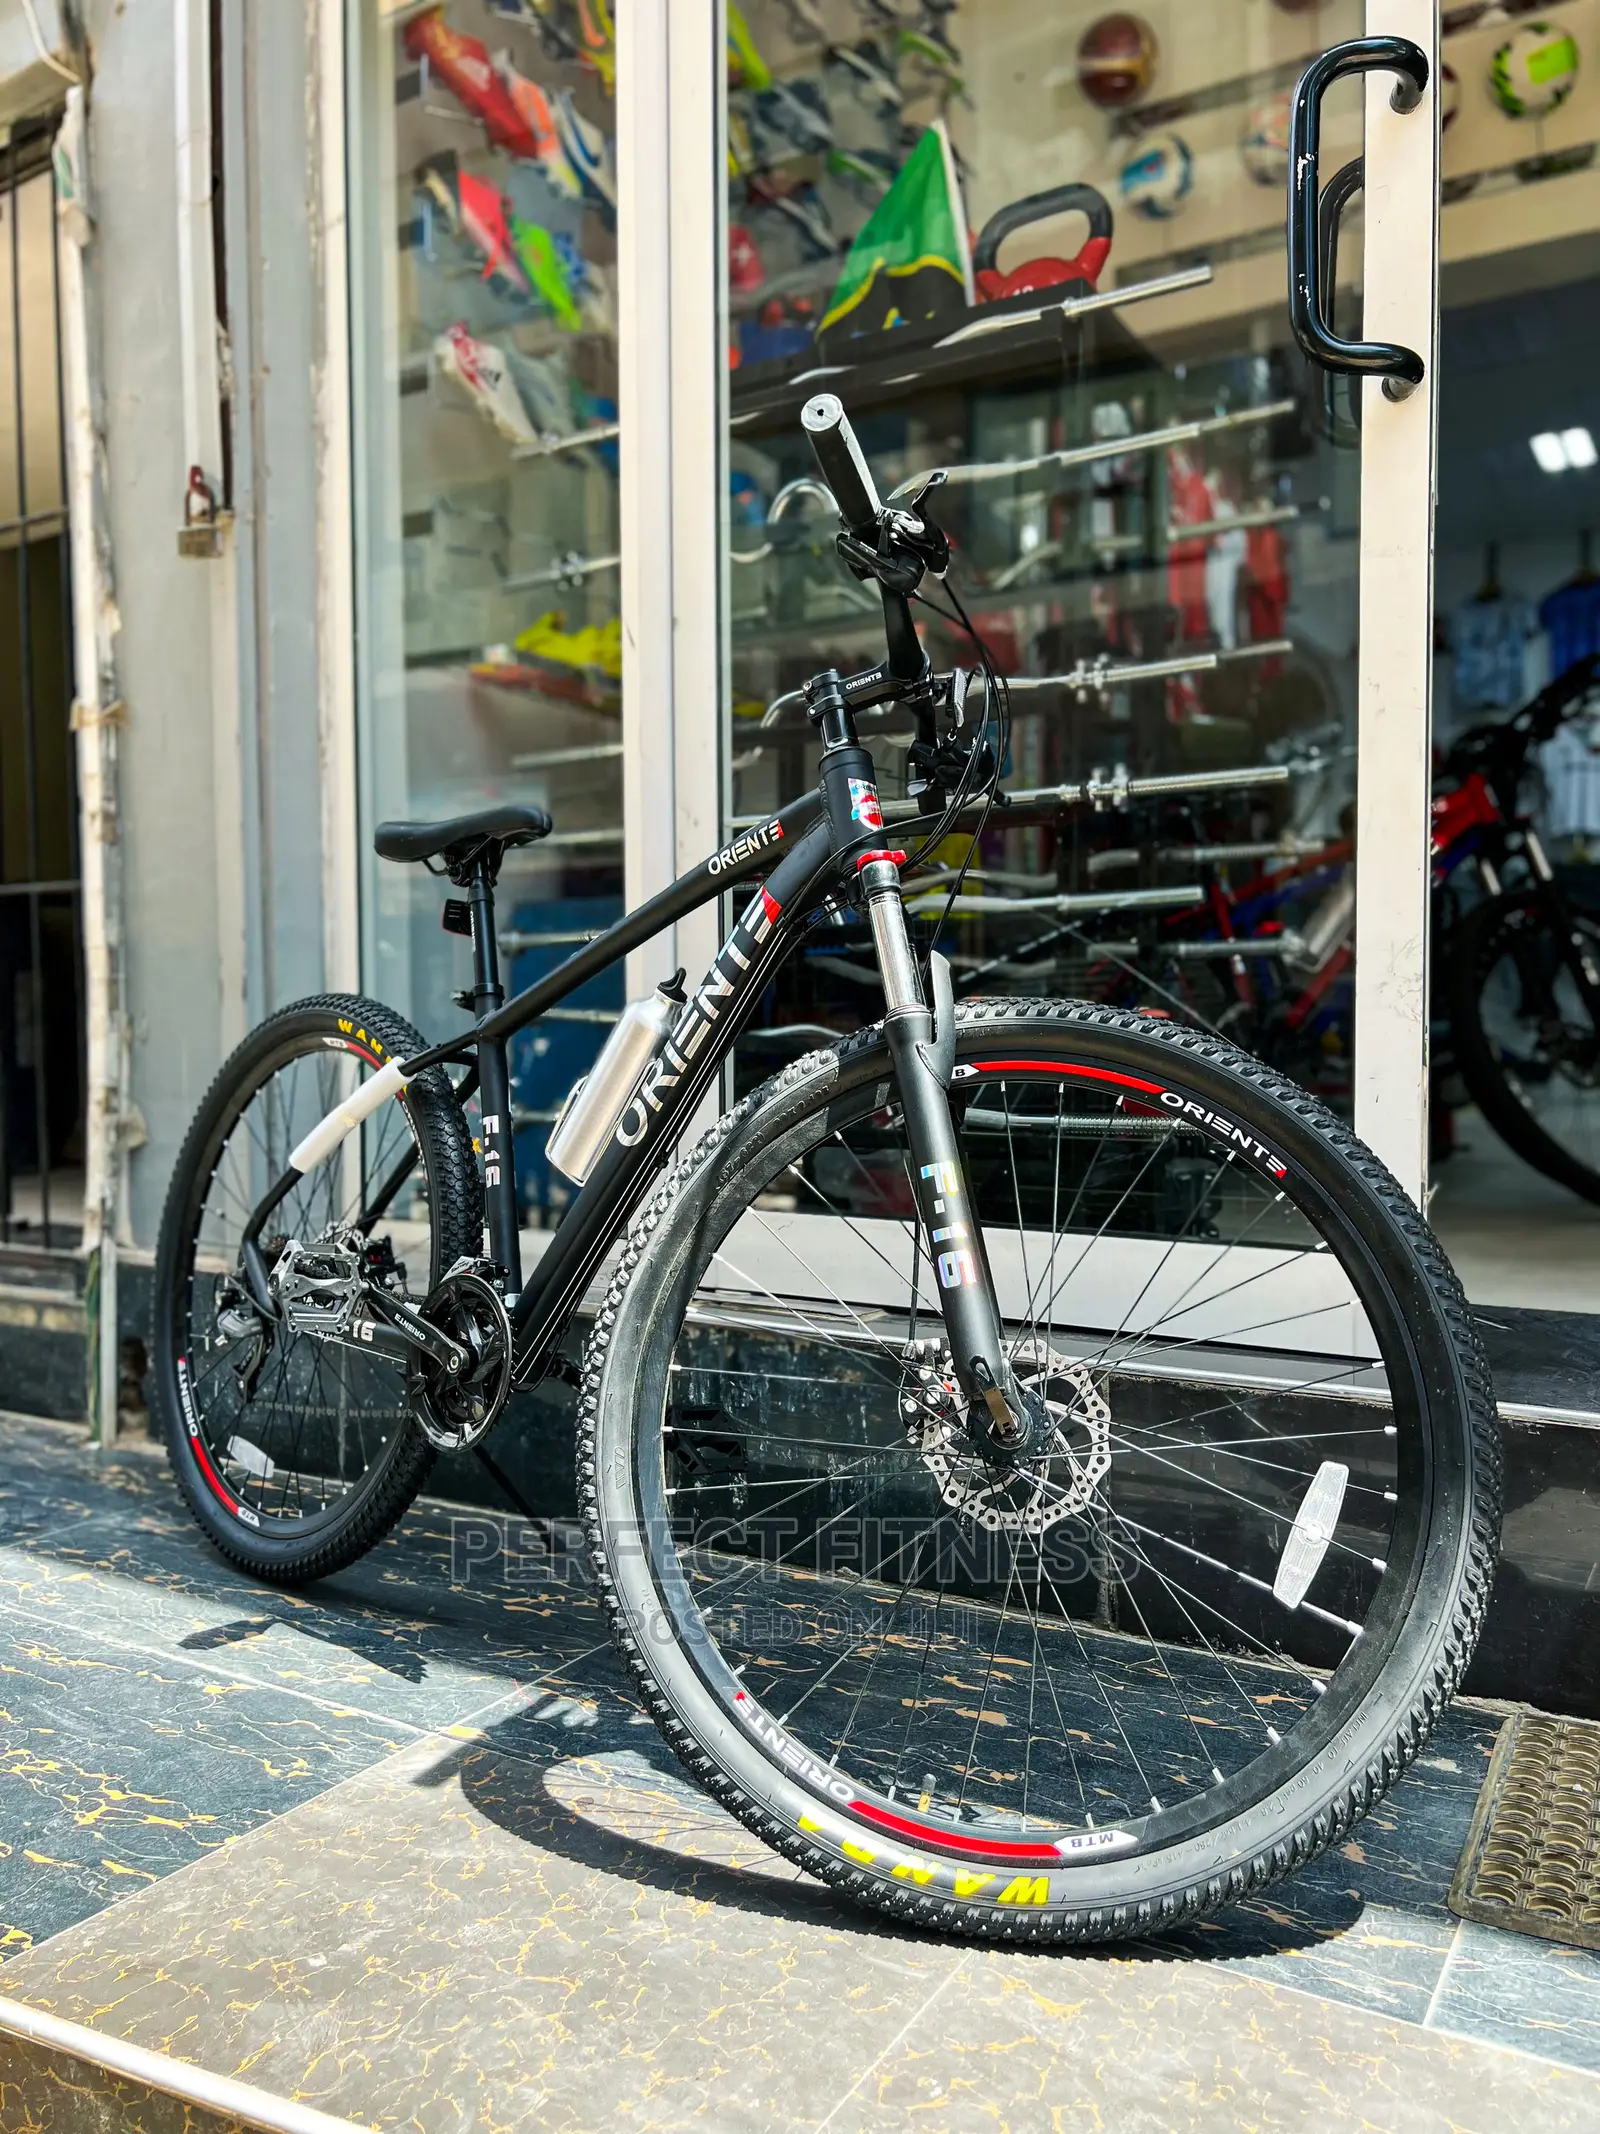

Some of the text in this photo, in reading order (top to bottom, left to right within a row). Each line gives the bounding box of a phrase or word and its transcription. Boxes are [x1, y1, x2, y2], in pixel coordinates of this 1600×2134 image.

[708, 819, 785, 876] ORIENTE
[616, 886, 782, 1147] ORIENTE
[1160, 1092, 1288, 1179] ORIENTE
[344, 1319, 377, 1342] -16
[394, 1313, 426, 1341] ORIENTE
[733, 1690, 855, 1801] ORIENTE
[1070, 1832, 1114, 1848] MTB
